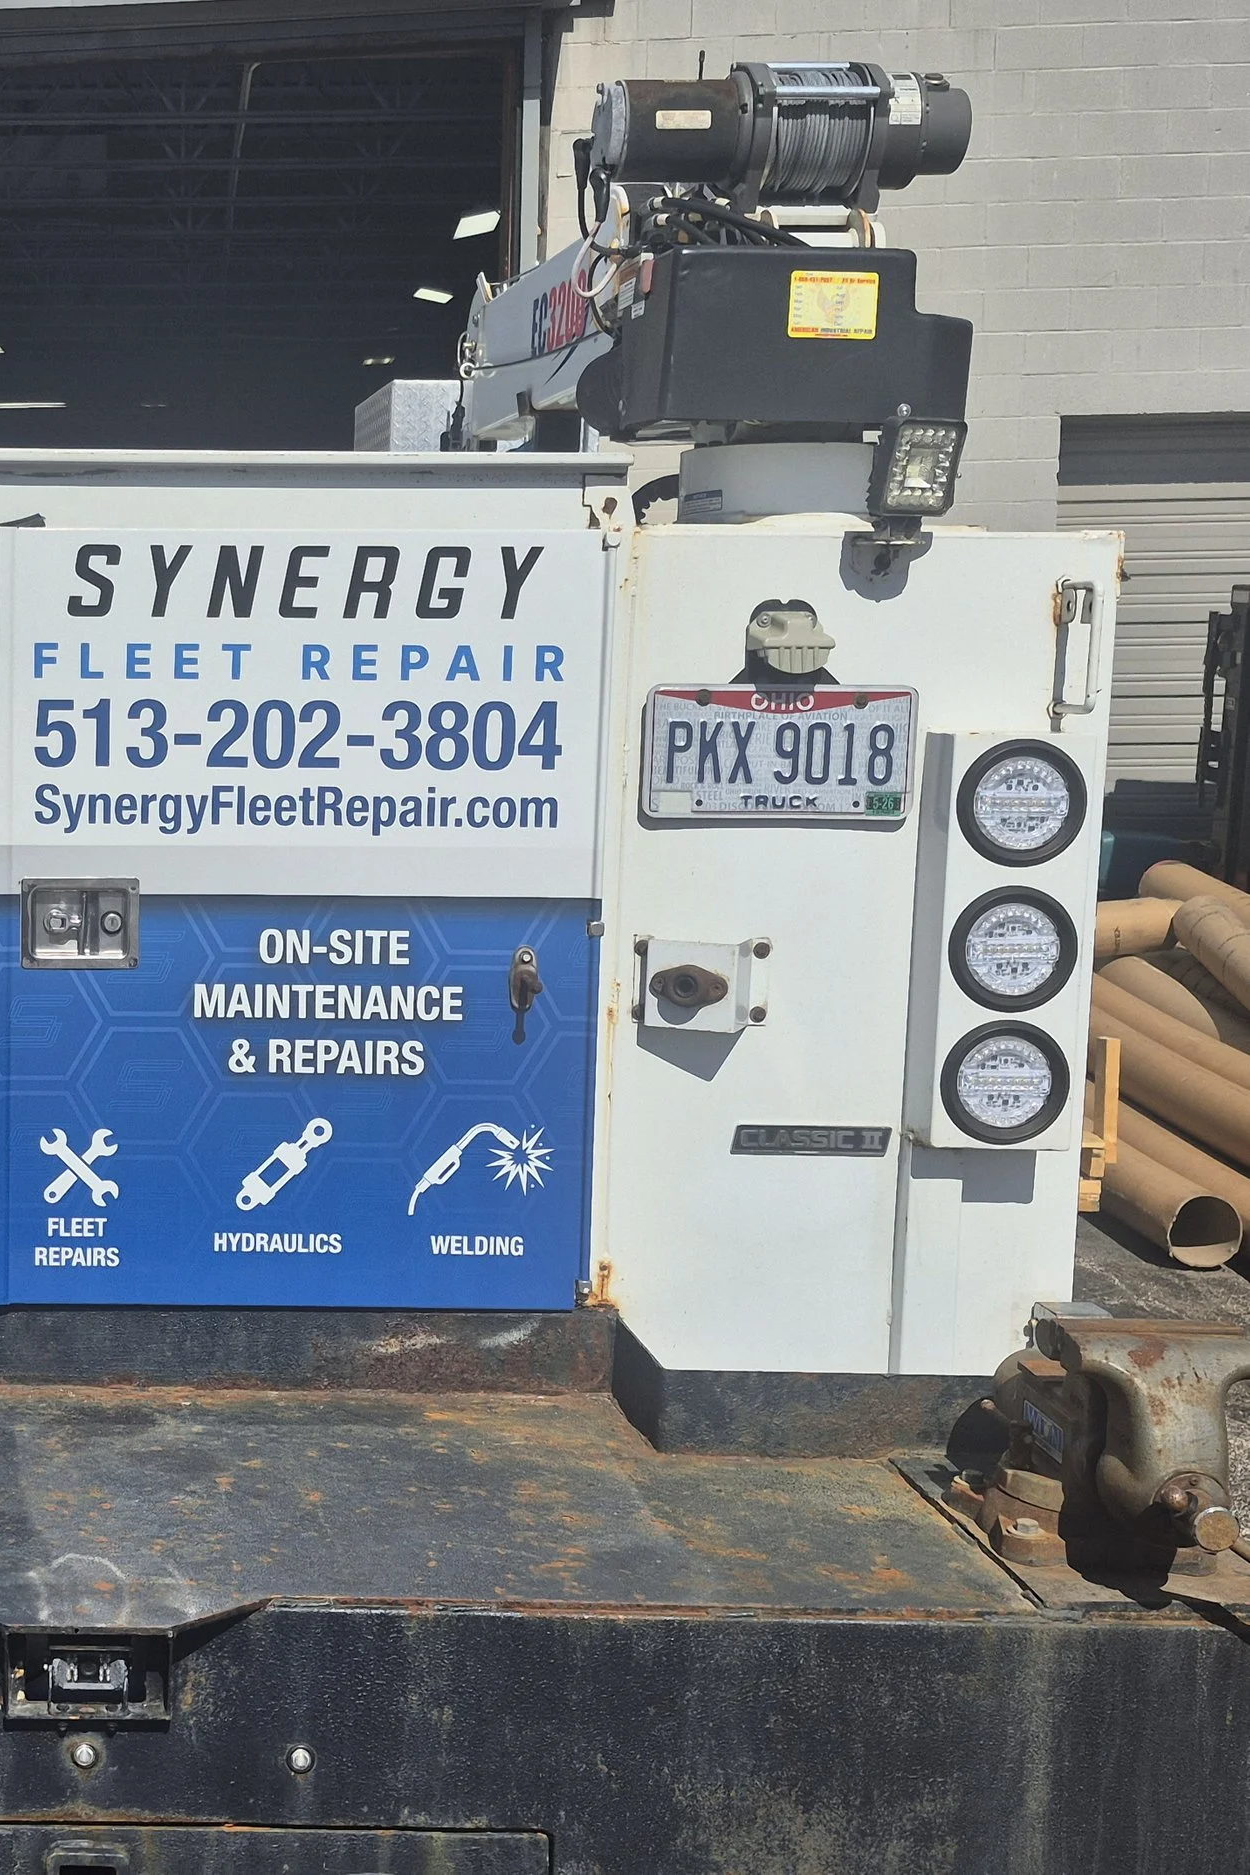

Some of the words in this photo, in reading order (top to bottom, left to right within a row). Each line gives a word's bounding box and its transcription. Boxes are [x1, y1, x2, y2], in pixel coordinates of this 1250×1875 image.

[67, 544, 545, 619] SYNERGY
[33, 642, 252, 680] FLEET
[301, 644, 565, 682] REPAIR
[750, 690, 815, 712] OHIO
[714, 711, 779, 720] BIRTHPLACE
[781, 712, 794, 721] OF
[797, 711, 848, 721] AVIATION
[34, 698, 563, 771] 513-202-3804
[665, 720, 756, 784] PKX
[773, 721, 895, 786] 9018
[696, 790, 723, 801] STEEL
[740, 794, 818, 809] TRUCK
[872, 797, 895, 810] 5-26
[34, 783, 559, 836] SynergyFleetRepair.com
[258, 928, 411, 966] ON-SITE
[193, 984, 464, 1022] MAINTENANCE
[228, 1039, 257, 1074] &
[268, 1040, 425, 1076] REPAIRS
[740, 1129, 854, 1149] CLASSIC
[861, 1131, 883, 1150] II
[47, 1217, 107, 1238] FLEET
[213, 1232, 343, 1255] HYDRAULICS
[430, 1234, 525, 1257] WELDING
[34, 1246, 120, 1267] REPAIRS
